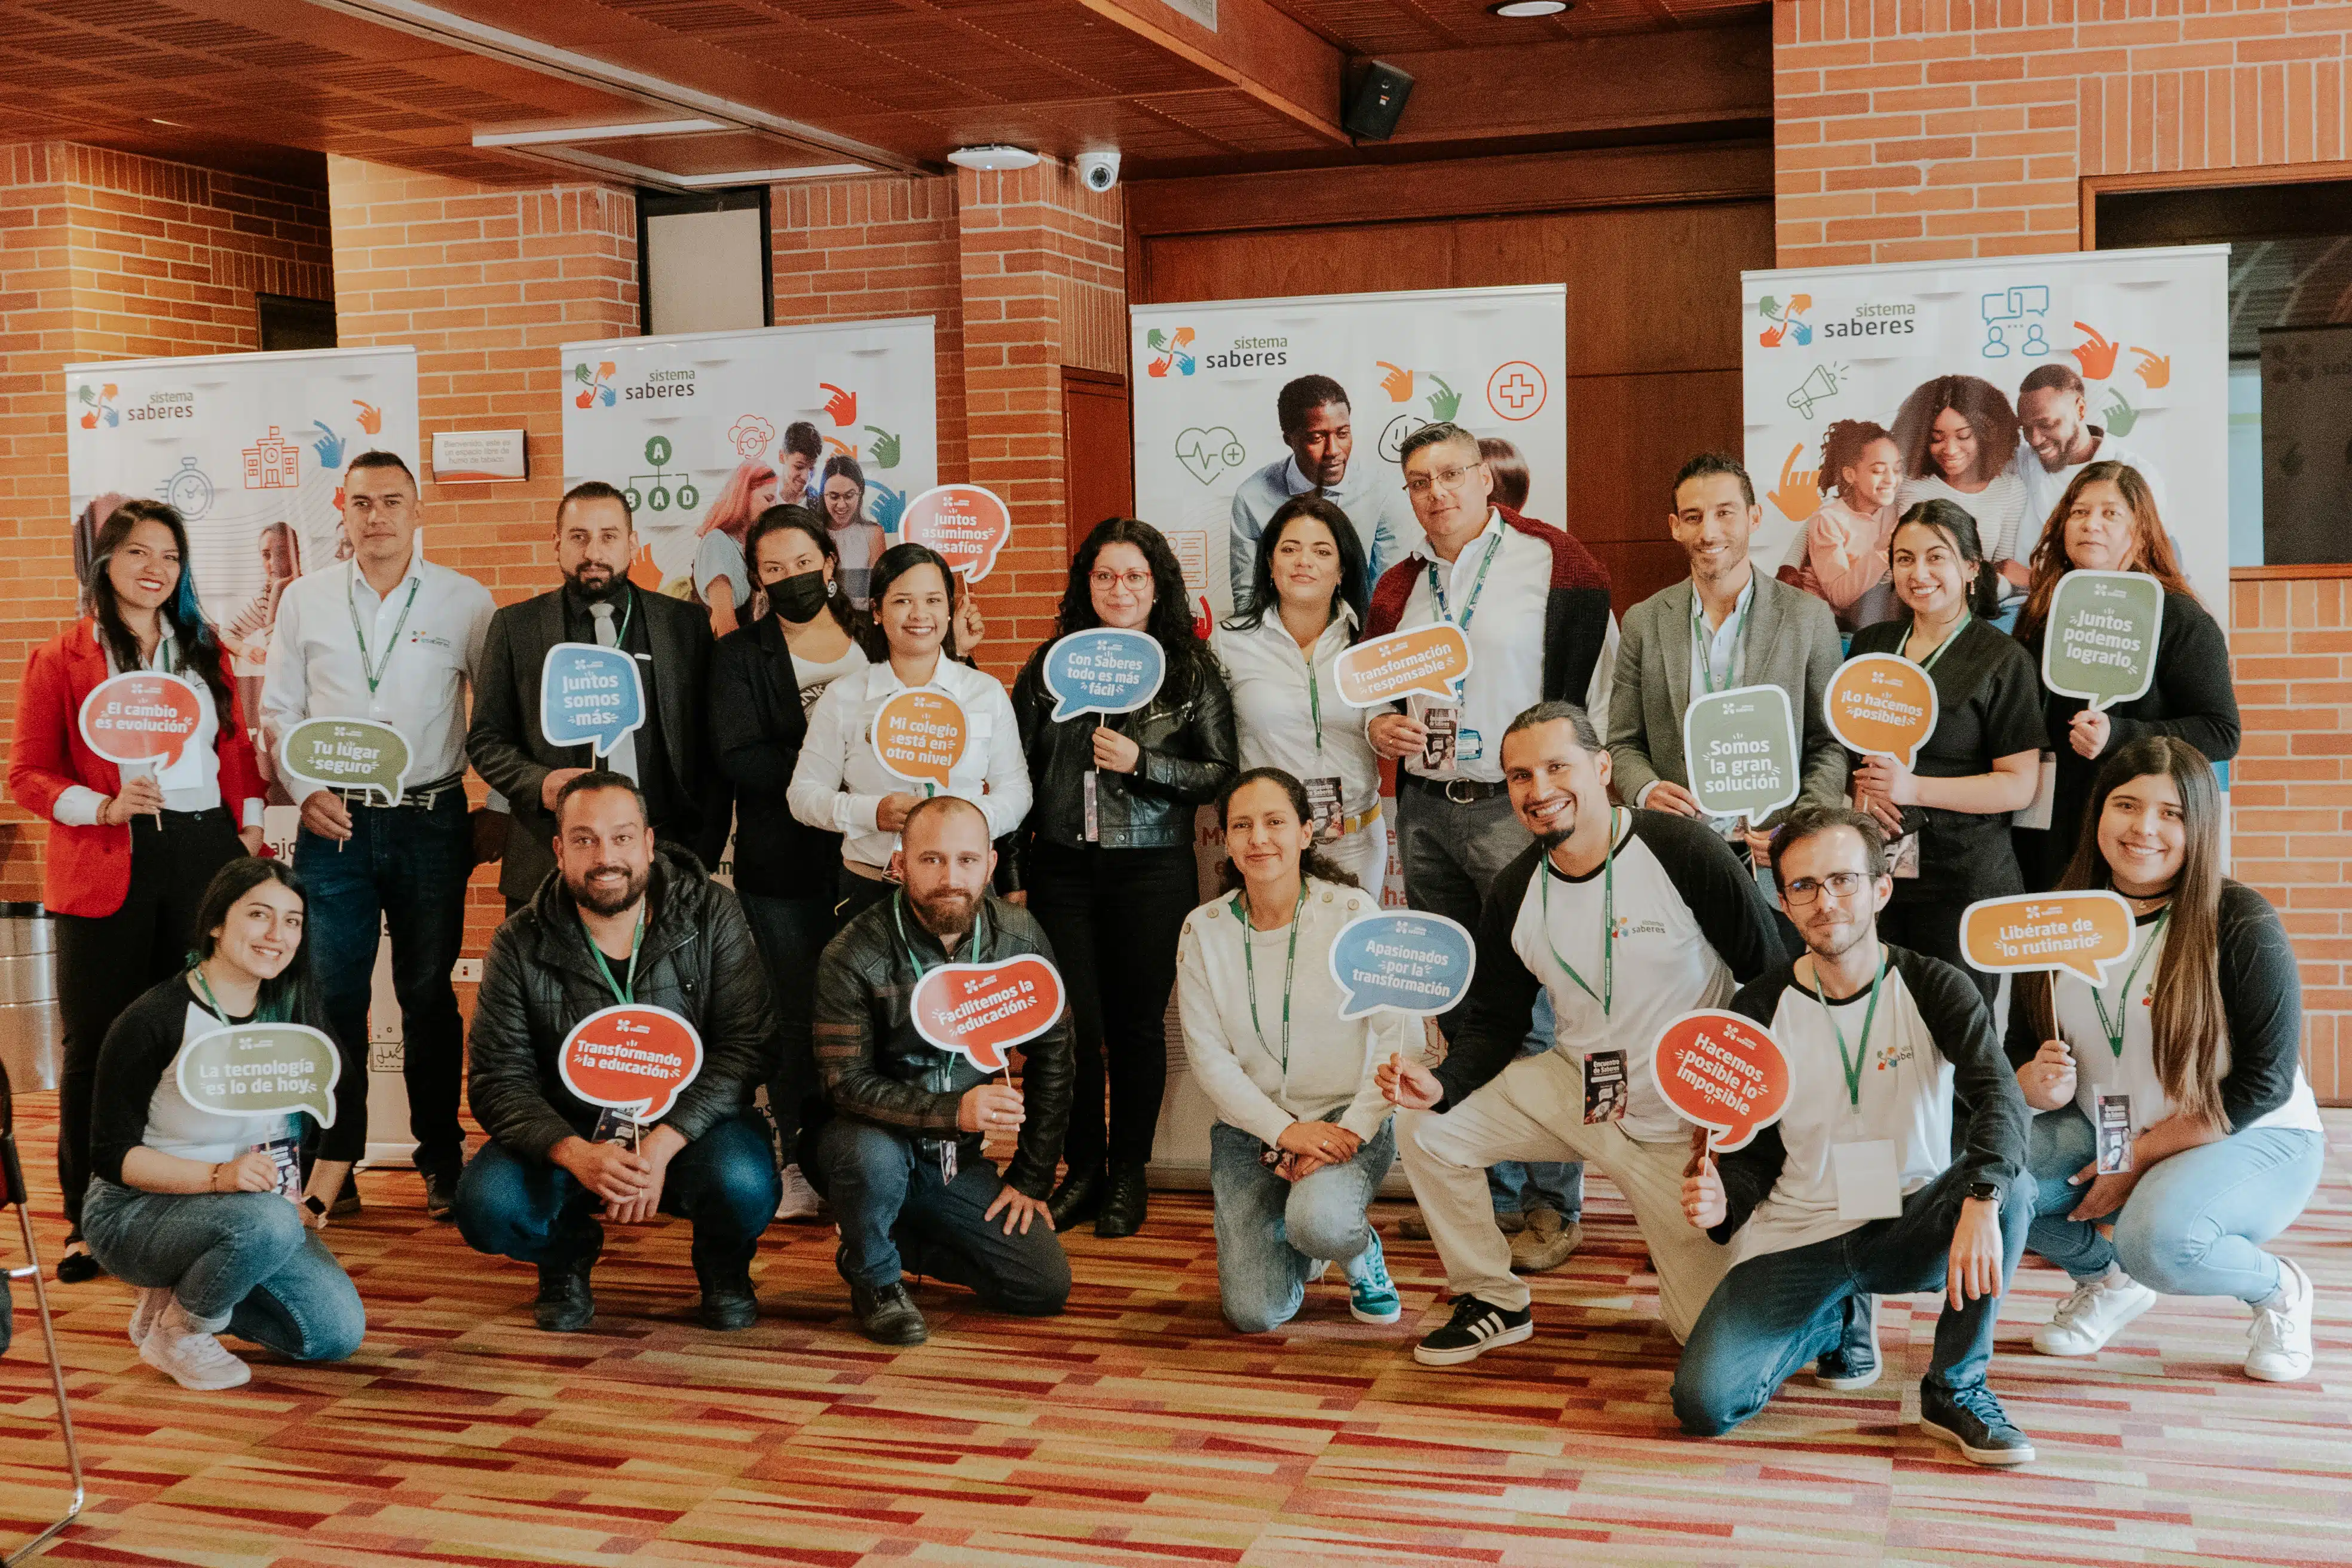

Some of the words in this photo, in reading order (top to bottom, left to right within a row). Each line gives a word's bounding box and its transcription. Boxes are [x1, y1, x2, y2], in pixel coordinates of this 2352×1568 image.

[1855, 303, 1915, 317] sistema
[1824, 318, 1915, 338] saberes
[1234, 336, 1288, 350] sistema
[1206, 350, 1287, 368] saberes
[649, 369, 695, 382] sistema
[150, 392, 194, 403] sistema
[626, 382, 695, 400] saberes
[128, 404, 194, 421] saberes
[653, 443, 664, 459] A
[654, 491, 664, 507] A
[682, 490, 693, 505] D
[933, 512, 977, 526] Juntos
[922, 526, 989, 540] asumimos
[927, 540, 983, 554] desafíos
[2077, 609, 2133, 632] Juntos
[2063, 627, 2141, 651] podemos
[1068, 653, 1091, 666] Con
[1094, 654, 1143, 670] Saberes
[1352, 644, 1451, 684] Transformación
[2066, 642, 2131, 668] lograrlo
[562, 675, 619, 694] Juntos
[1067, 667, 1095, 681] todo
[1098, 671, 1113, 682] es
[1115, 670, 1140, 685] más
[1367, 660, 1446, 694] responsable
[1088, 682, 1115, 697] fácil
[107, 702, 121, 715] El
[124, 704, 177, 718] cambio
[564, 693, 620, 708] somos
[1841, 690, 1862, 703] ¡Lo
[1864, 693, 1923, 716] hacemos
[95, 718, 112, 729] es
[116, 718, 188, 733] evolución
[575, 708, 611, 726] más
[1853, 707, 1907, 727] posible!
[890, 716, 906, 730] Mi
[909, 721, 958, 738] colegio
[313, 740, 333, 755] Tu
[337, 742, 381, 760] lugar
[896, 734, 926, 748] está
[930, 739, 947, 751] en
[1710, 739, 1770, 756] Somos
[887, 746, 915, 761] otro
[918, 750, 952, 766] nivel
[315, 758, 372, 774] seguro
[1710, 758, 1726, 774] la
[1731, 758, 1772, 776] gran
[1705, 773, 1780, 793] solución
[1632, 925, 1665, 933] saberes
[2000, 922, 2068, 941] Libérate
[2072, 917, 2093, 932] de
[1365, 939, 1449, 966] Apasionados
[2002, 942, 2018, 957] lo
[2022, 934, 2094, 955] rutinario
[1386, 961, 1408, 974] por
[1411, 963, 1424, 977] la
[1352, 967, 1450, 997] transformación
[938, 985, 1018, 1026] Facilitemos
[1018, 980, 1034, 993] la
[957, 999, 1028, 1035] educación
[577, 1039, 682, 1067] Transformando
[1694, 1032, 1764, 1082] Hacemos
[200, 1064, 219, 1078] La
[225, 1058, 315, 1077] tecnología
[582, 1054, 596, 1067] la
[598, 1058, 669, 1079] educación
[1682, 1050, 1741, 1090] posible
[1741, 1080, 1758, 1099] lo
[206, 1083, 225, 1095] es
[230, 1079, 247, 1094] lo
[250, 1077, 273, 1093] de
[277, 1076, 310, 1094] hoy
[1676, 1065, 1750, 1116] imposible
